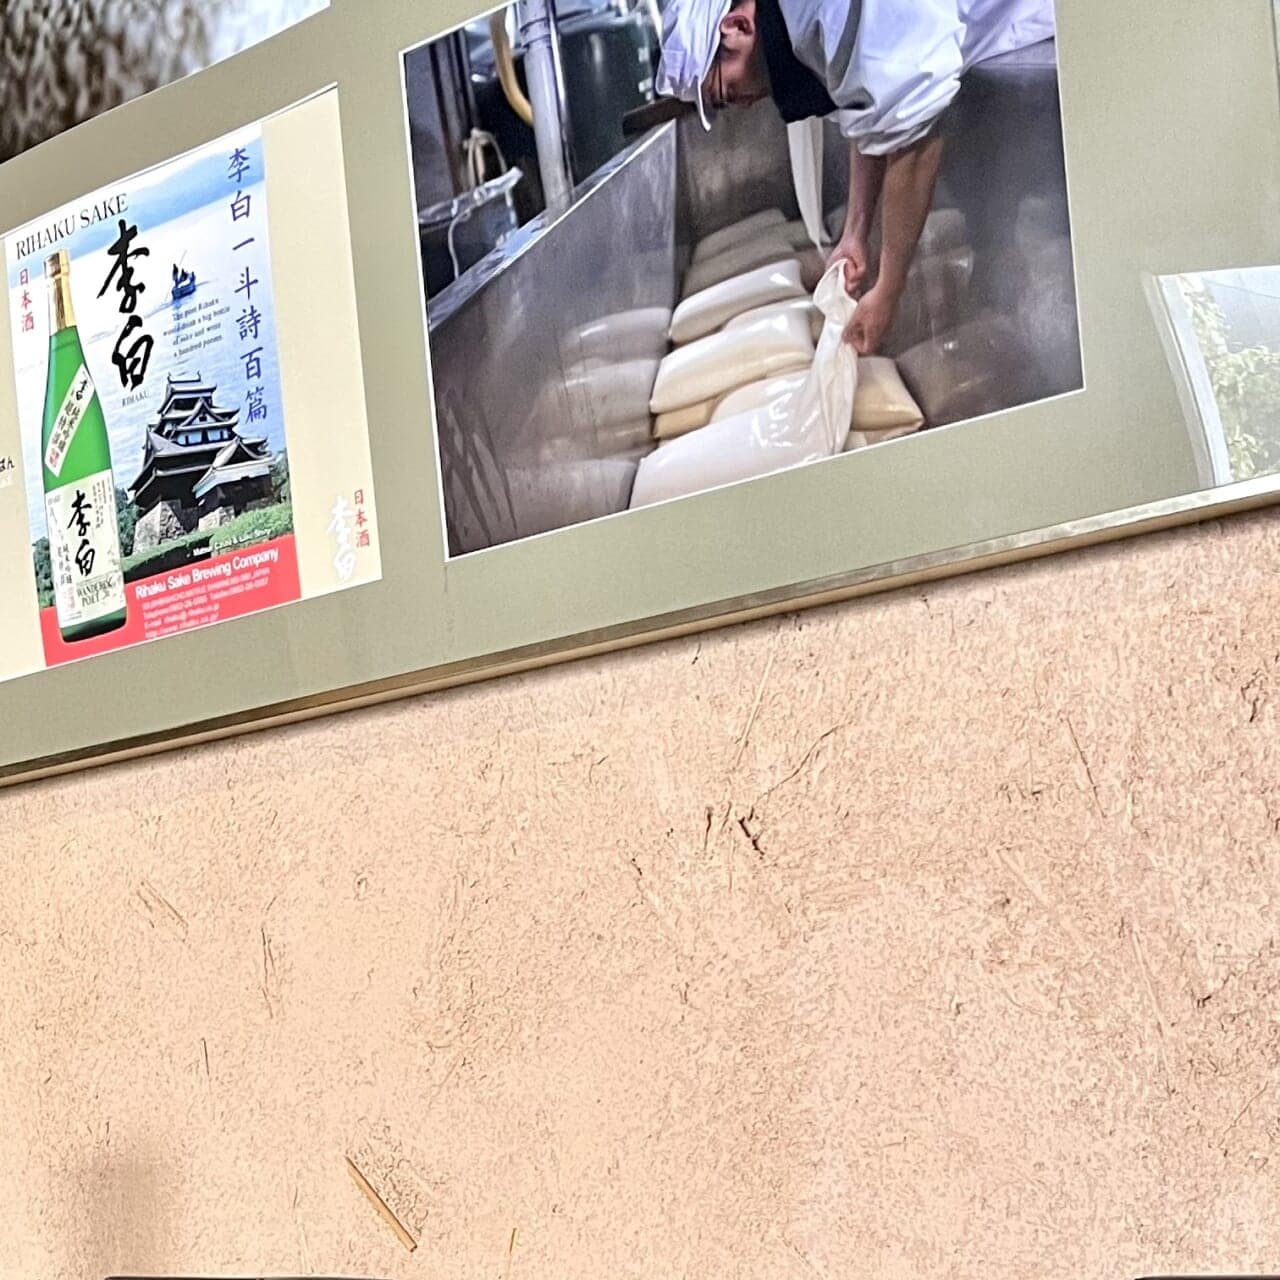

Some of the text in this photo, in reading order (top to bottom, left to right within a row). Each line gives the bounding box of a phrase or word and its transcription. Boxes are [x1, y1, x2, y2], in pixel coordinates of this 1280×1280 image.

[16, 193, 129, 260] RIHAKU SAKE
[19, 267, 36, 333] 日本酒
[97, 219, 154, 392] 李白
[227, 147, 268, 424] 李白一斗詩百篇
[353, 489, 371, 550] 日本酒
[135, 548, 279, 599] Rihaku Sake Brewing Company
